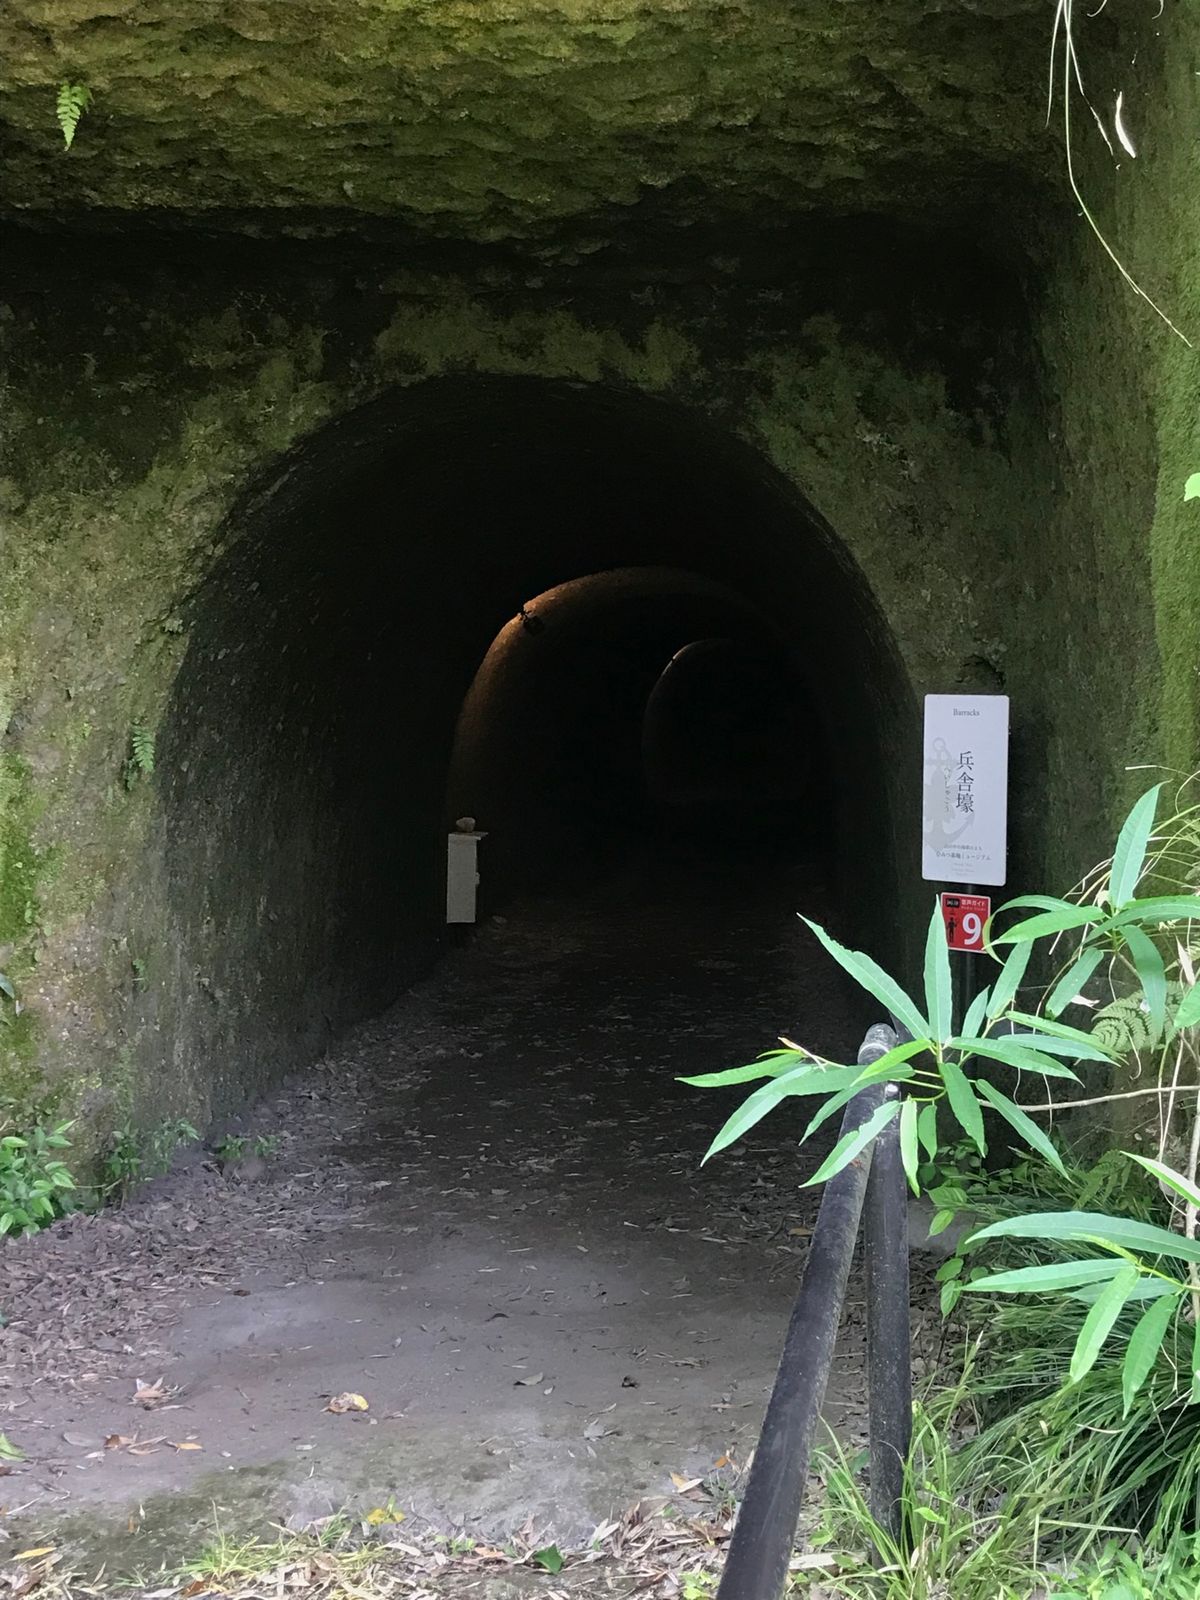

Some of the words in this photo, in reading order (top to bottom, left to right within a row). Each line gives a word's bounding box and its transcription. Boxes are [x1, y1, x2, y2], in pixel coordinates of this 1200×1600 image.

[953, 708, 980, 716] Barracks
[955, 750, 975, 814] 兵舎壕
[962, 912, 982, 945] 9
